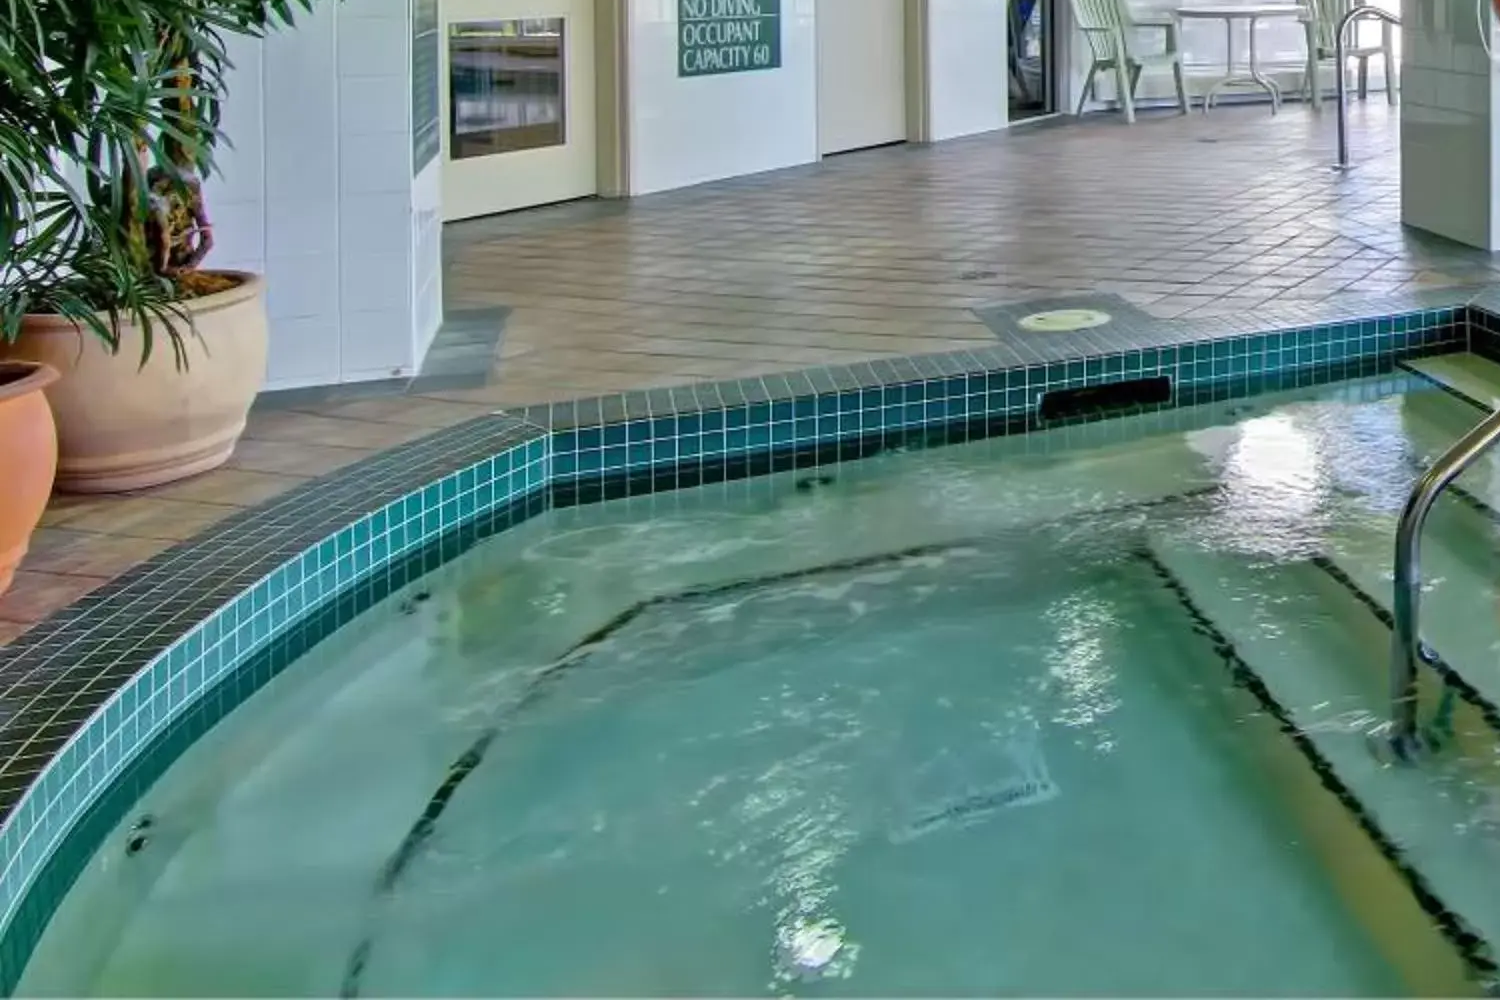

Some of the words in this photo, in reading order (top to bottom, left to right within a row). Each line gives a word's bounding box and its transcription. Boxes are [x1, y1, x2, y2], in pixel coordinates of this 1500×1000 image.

[683, 21, 761, 46] OCCUPANT
[683, 45, 751, 71] CAPACITY
[753, 44, 769, 65] 60
